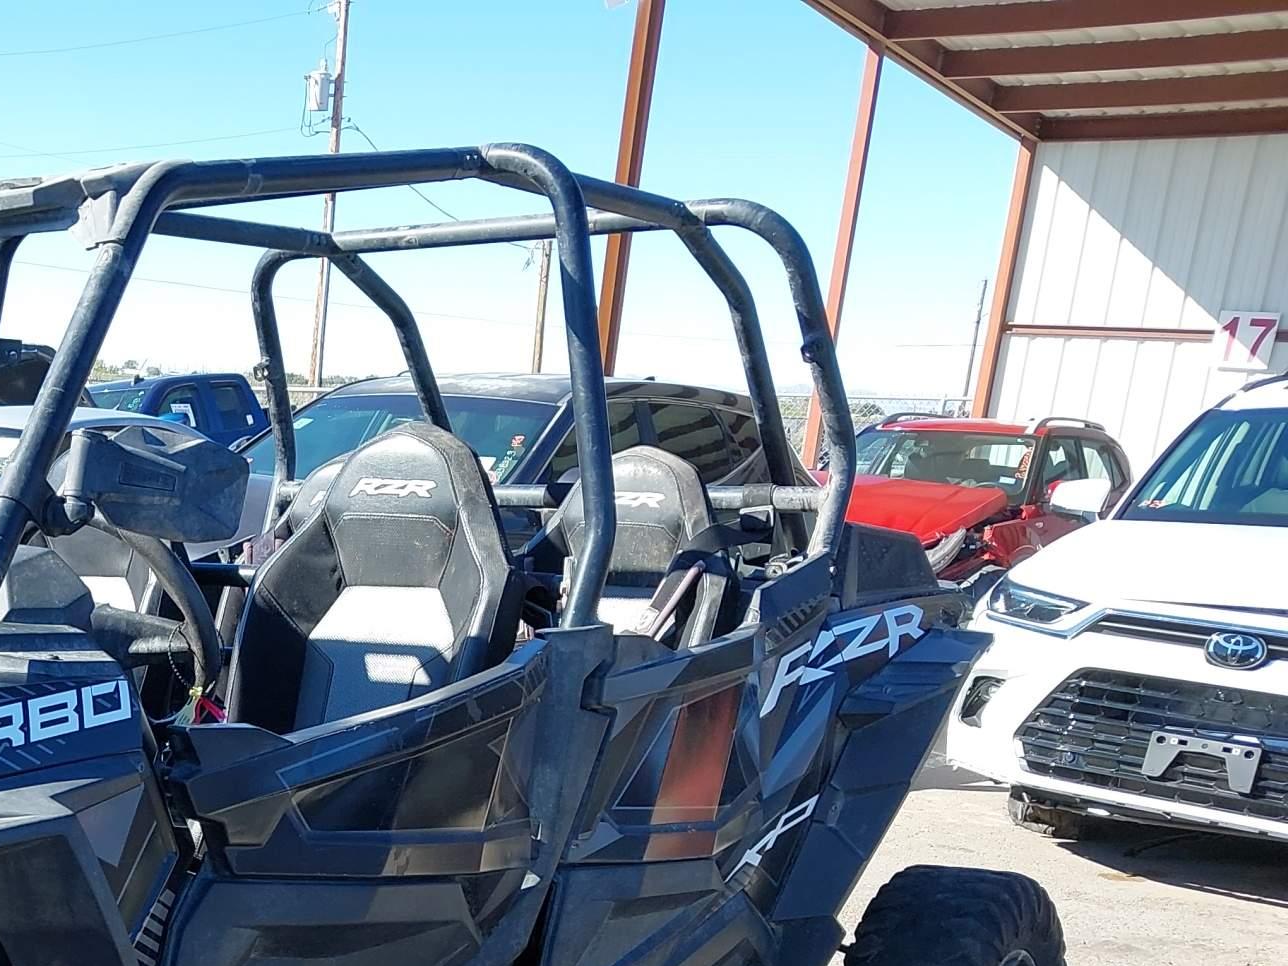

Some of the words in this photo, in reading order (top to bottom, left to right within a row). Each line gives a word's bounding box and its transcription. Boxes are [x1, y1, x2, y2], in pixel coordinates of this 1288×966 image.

[1221, 316, 1278, 362] 17
[348, 476, 438, 499] RZR
[615, 491, 666, 508] ZR
[759, 604, 925, 719] RZR
